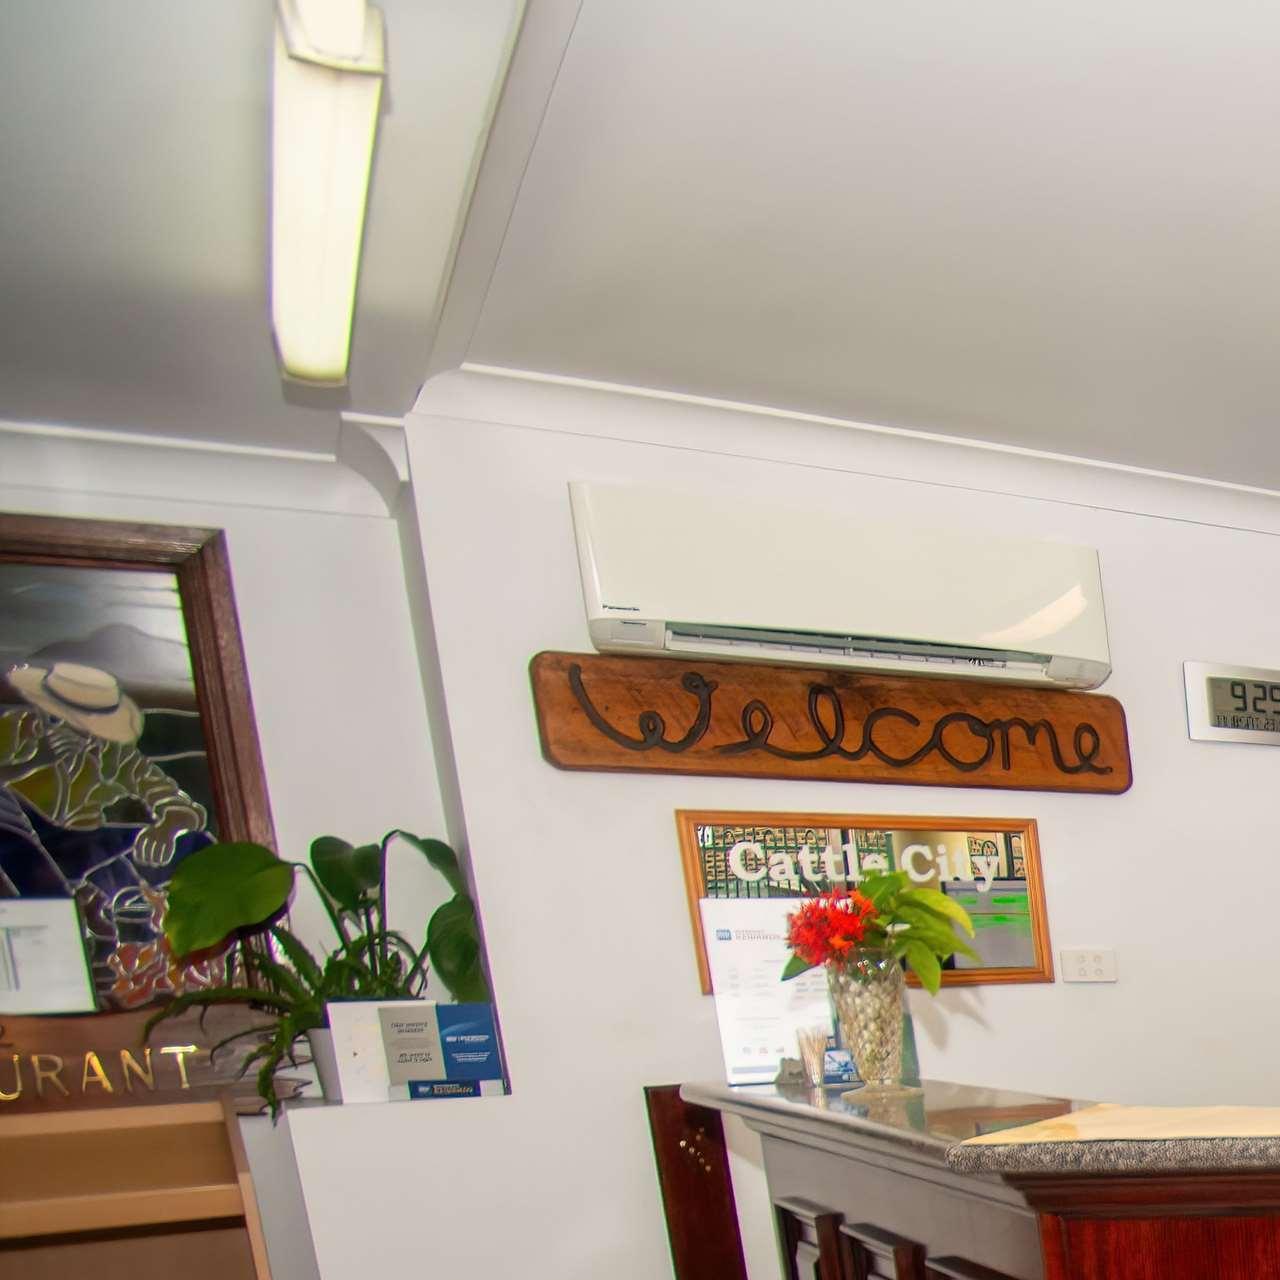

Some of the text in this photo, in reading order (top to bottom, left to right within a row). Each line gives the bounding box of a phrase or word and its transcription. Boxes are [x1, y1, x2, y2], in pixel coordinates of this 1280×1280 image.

[568, 664, 1113, 776] Welcome
[728, 841, 999, 892] Cattle City
